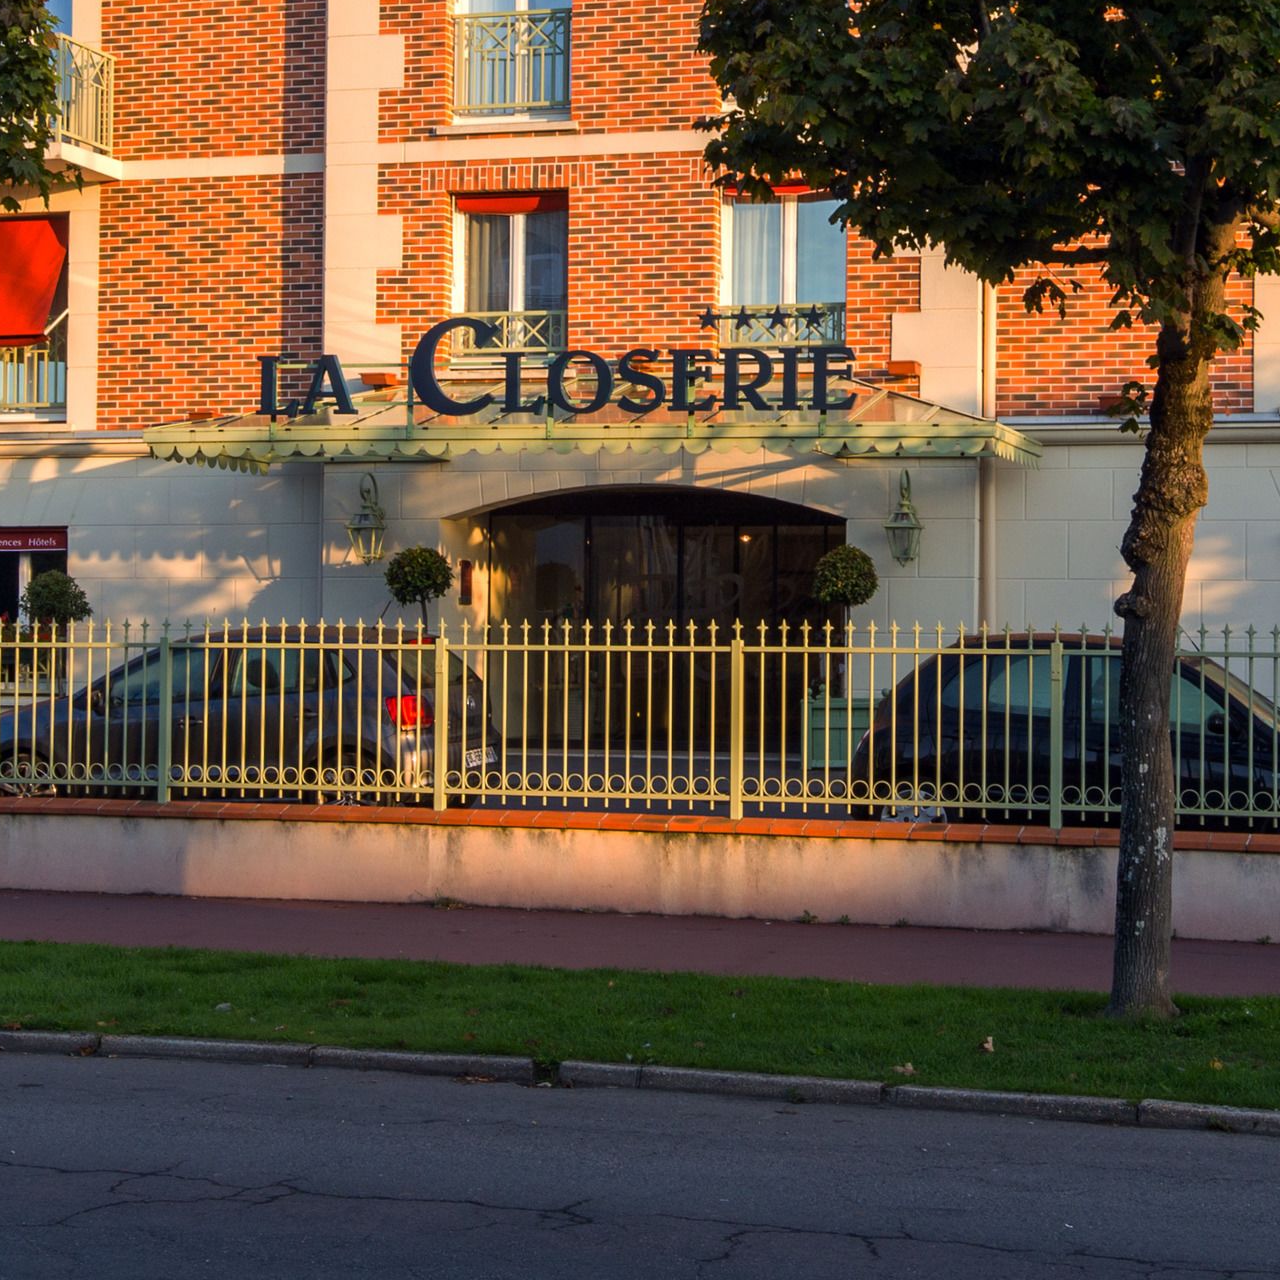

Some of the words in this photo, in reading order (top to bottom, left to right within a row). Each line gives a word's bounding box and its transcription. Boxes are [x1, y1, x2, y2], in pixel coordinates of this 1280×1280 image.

[256, 354, 358, 417] LA
[411, 317, 858, 416] CLOSERIE
[28, 537, 56, 546] Hôtels
